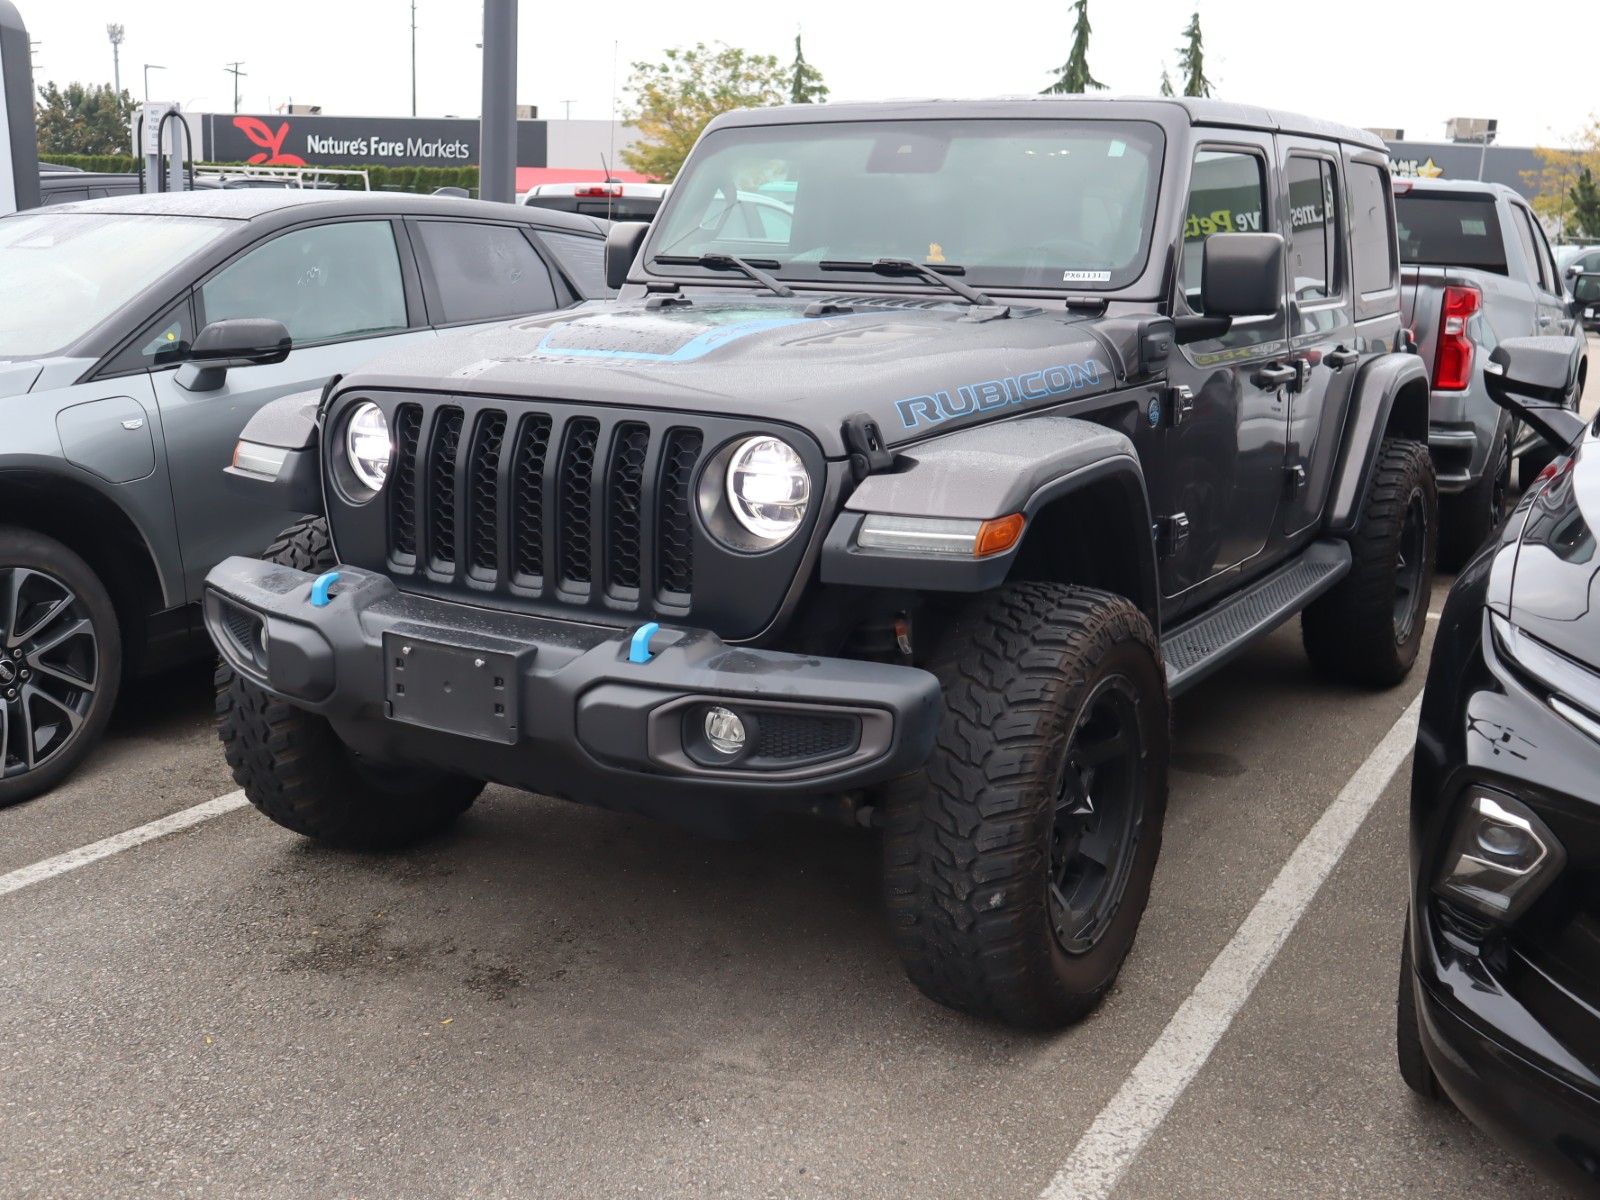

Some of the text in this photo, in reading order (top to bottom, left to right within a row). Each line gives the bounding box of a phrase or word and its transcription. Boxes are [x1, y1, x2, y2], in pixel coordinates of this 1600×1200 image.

[307, 134, 469, 159] Nature's Fare Markets
[894, 359, 1101, 428] RUBICON
